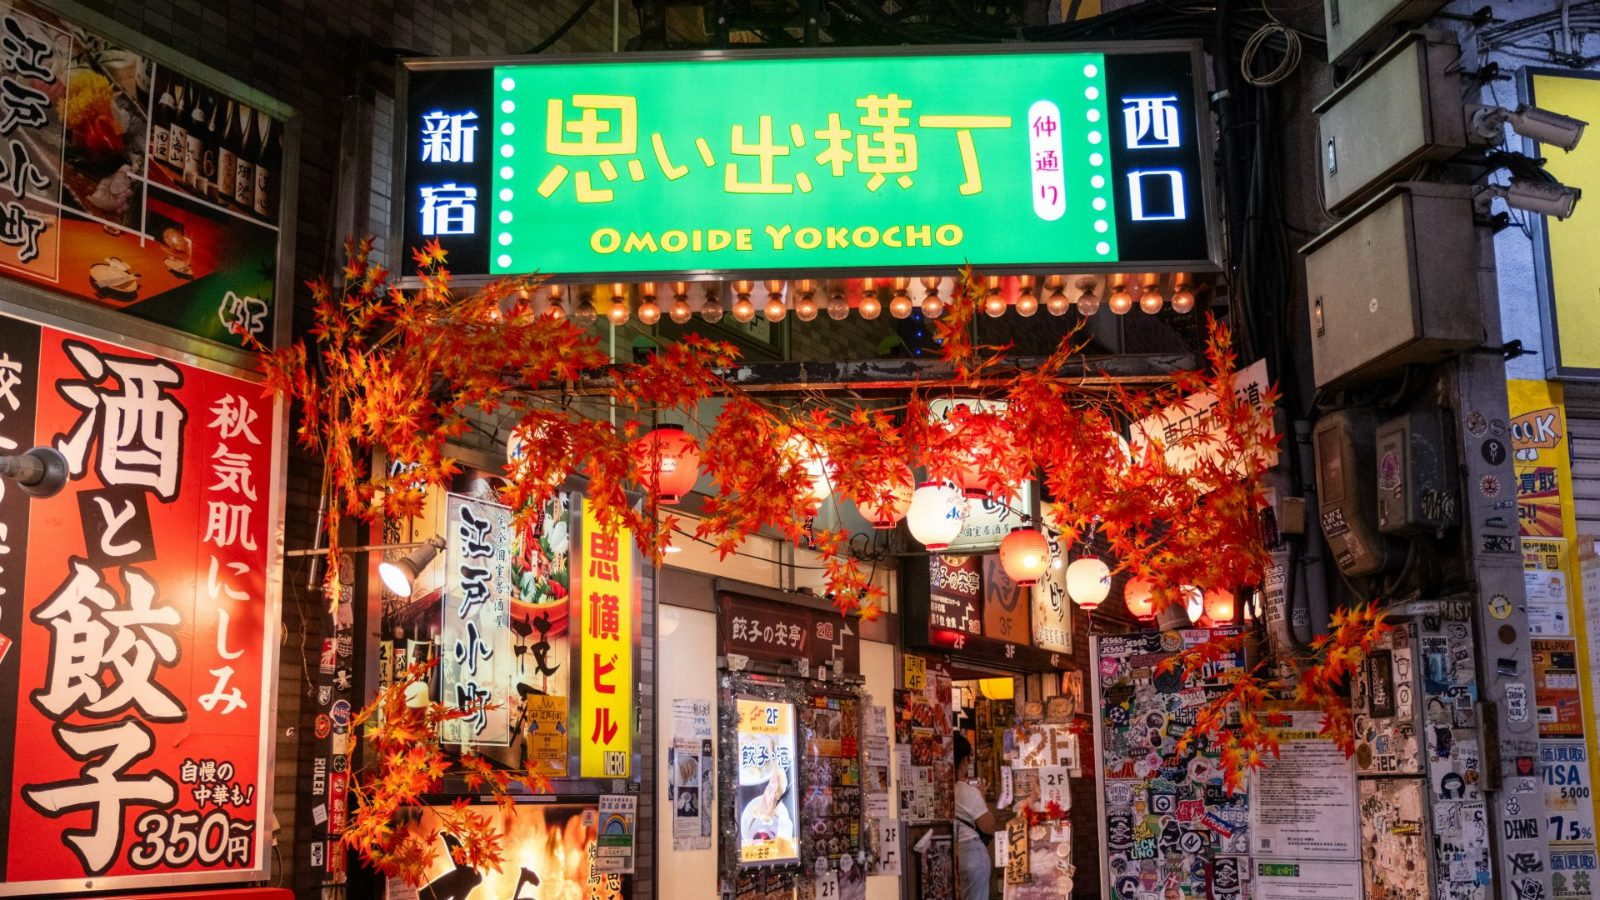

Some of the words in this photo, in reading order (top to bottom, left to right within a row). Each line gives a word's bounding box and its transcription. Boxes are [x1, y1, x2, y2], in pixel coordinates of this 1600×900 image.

[537, 93, 1012, 203] 思い出横丁
[1032, 115, 1060, 206] 仲通り
[1121, 95, 1187, 221] 西口
[419, 111, 479, 236] 新宿
[590, 228, 753, 254] OMOIDE
[765, 224, 963, 250] YOKOCHO
[198, 392, 262, 715] 秋気肌にしみ
[456, 506, 494, 735] 江戸小町
[732, 616, 801, 647] 餃子の安亭
[588, 530, 621, 746] 思横ビル
[909, 675, 922, 688] 4F
[766, 708, 778, 725] 2F
[180, 760, 235, 783] 自慢の
[312, 758, 326, 796] RULER
[604, 752, 626, 776] NERO
[1047, 775, 1064, 786] 2F
[193, 785, 255, 807] 中華も!
[885, 828, 896, 842] 2F
[822, 883, 836, 896] 2F
